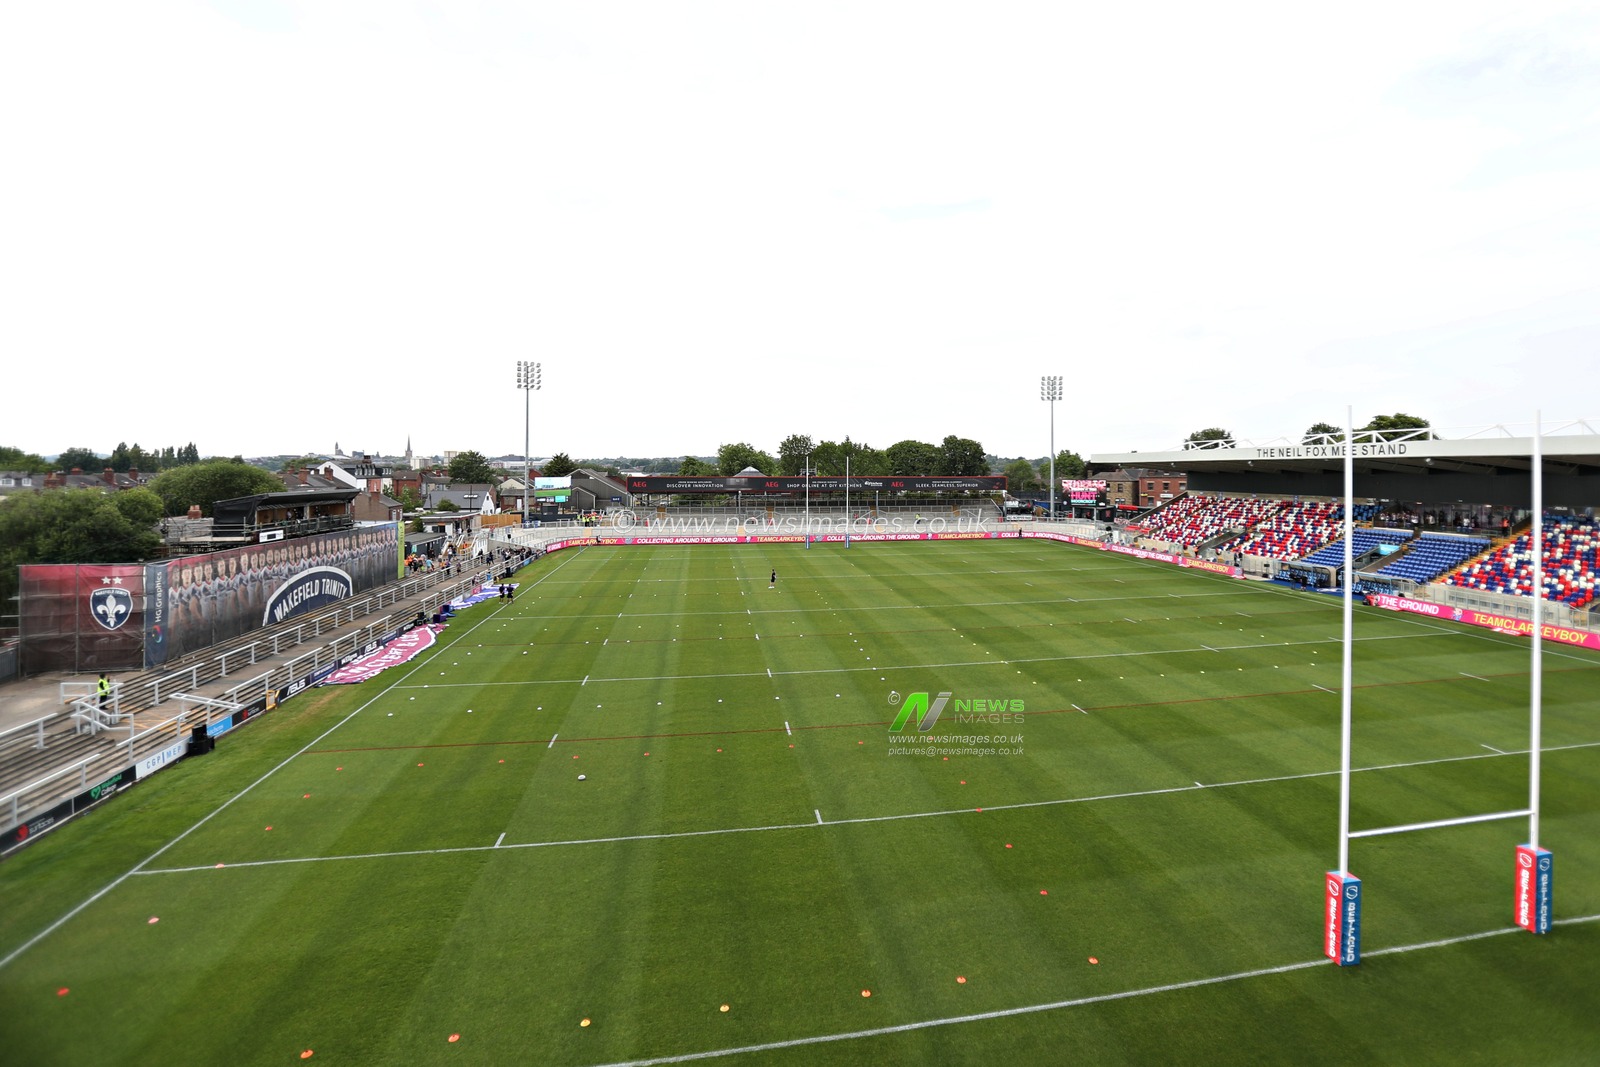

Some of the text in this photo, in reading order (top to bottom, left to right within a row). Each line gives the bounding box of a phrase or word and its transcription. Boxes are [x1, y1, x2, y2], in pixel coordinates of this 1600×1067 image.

[1257, 448, 1275, 458] THE
[1279, 447, 1302, 457] NEIL
[1306, 446, 1327, 457] FOX
[1361, 443, 1407, 456] STAND
[567, 538, 618, 546] TEAMCLARKYBOY
[273, 578, 348, 622] WAKEFIELD TRINITY
[1381, 595, 1398, 607] THE
[1399, 599, 1439, 615] GROUND
[286, 679, 306, 696] ASUS
[1347, 902, 1356, 962] BETFRED
